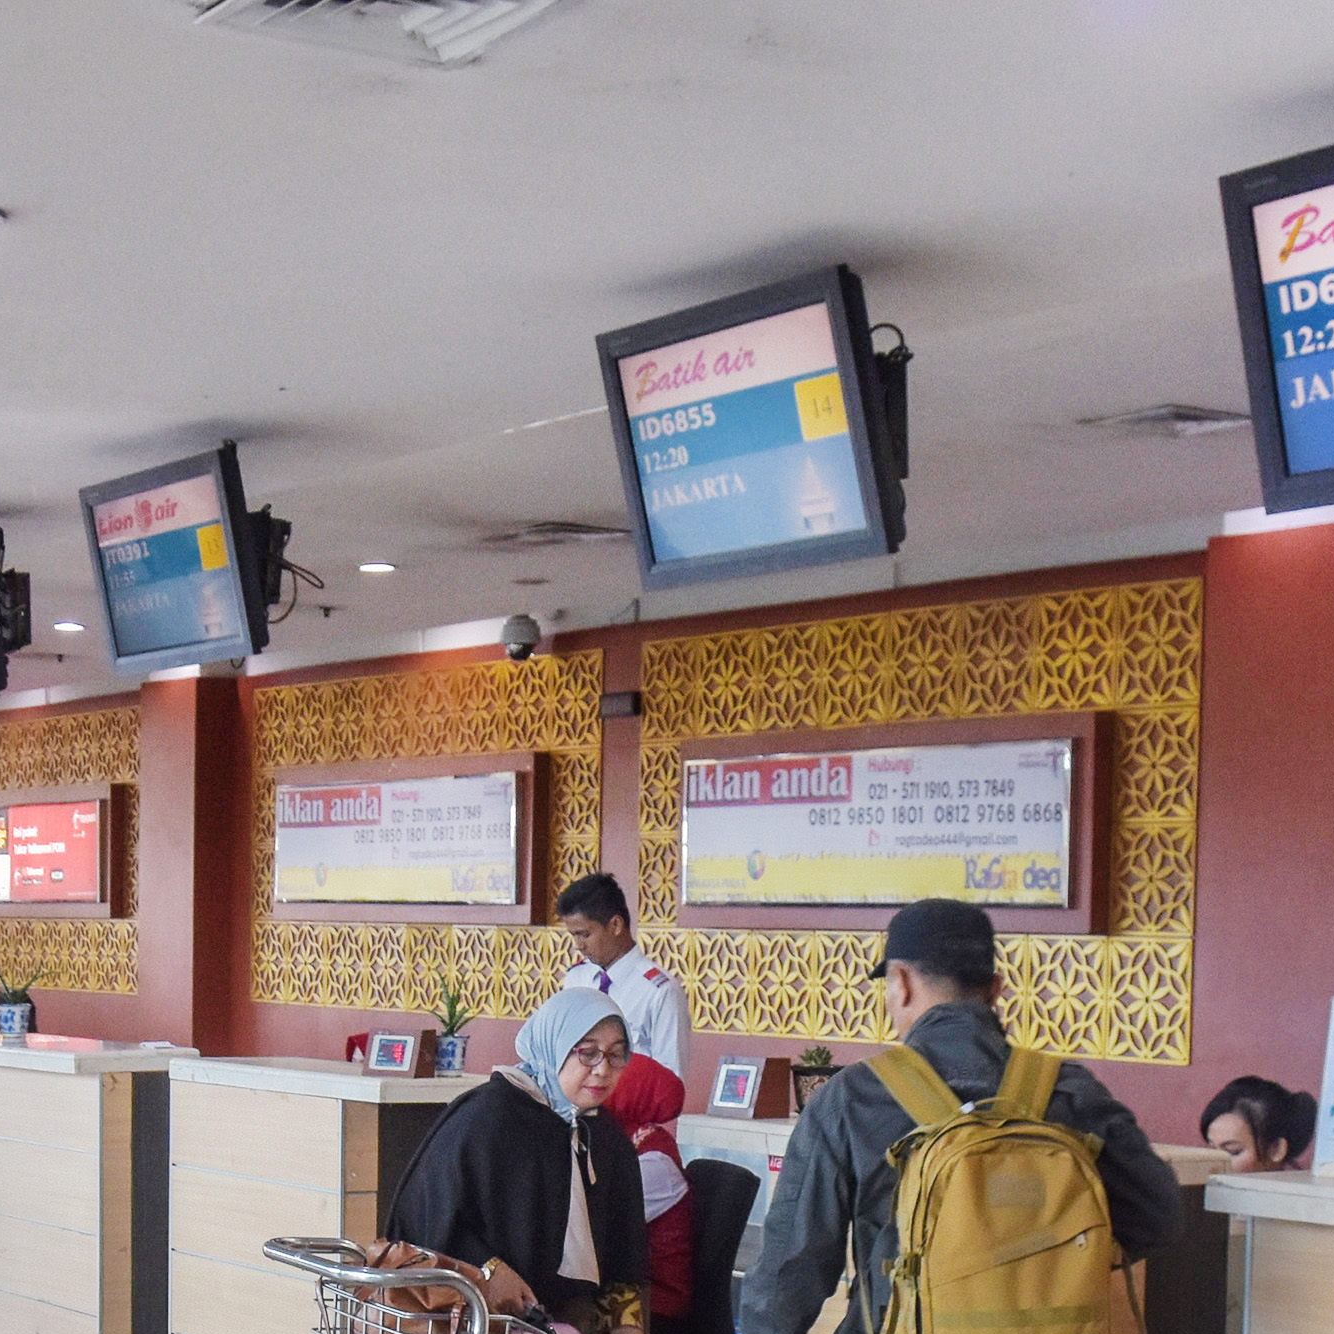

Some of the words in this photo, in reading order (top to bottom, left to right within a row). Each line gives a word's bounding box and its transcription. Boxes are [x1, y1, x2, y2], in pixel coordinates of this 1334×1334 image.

[635, 349, 706, 401] Batik
[813, 395, 832, 419] 14
[639, 403, 716, 441] ID6855
[643, 446, 689, 474] 12:20
[651, 472, 746, 511] JAKARTA
[98, 514, 134, 535] Lion
[105, 540, 150, 568] JT0391
[688, 762, 760, 803] iklan
[771, 759, 848, 801] anda
[869, 783, 888, 799] 021
[901, 781, 920, 798] 571
[958, 779, 979, 797] 573
[984, 779, 1014, 796] 7849
[279, 791, 323, 823] iklan
[330, 788, 380, 821] anda
[808, 807, 841, 826] 0812
[848, 806, 885, 825] 9850
[892, 805, 924, 824] 1801
[934, 804, 969, 824] 0812
[976, 803, 1015, 823] 9768
[1023, 802, 1063, 822] 6868
[1023, 859, 1062, 890] dea
